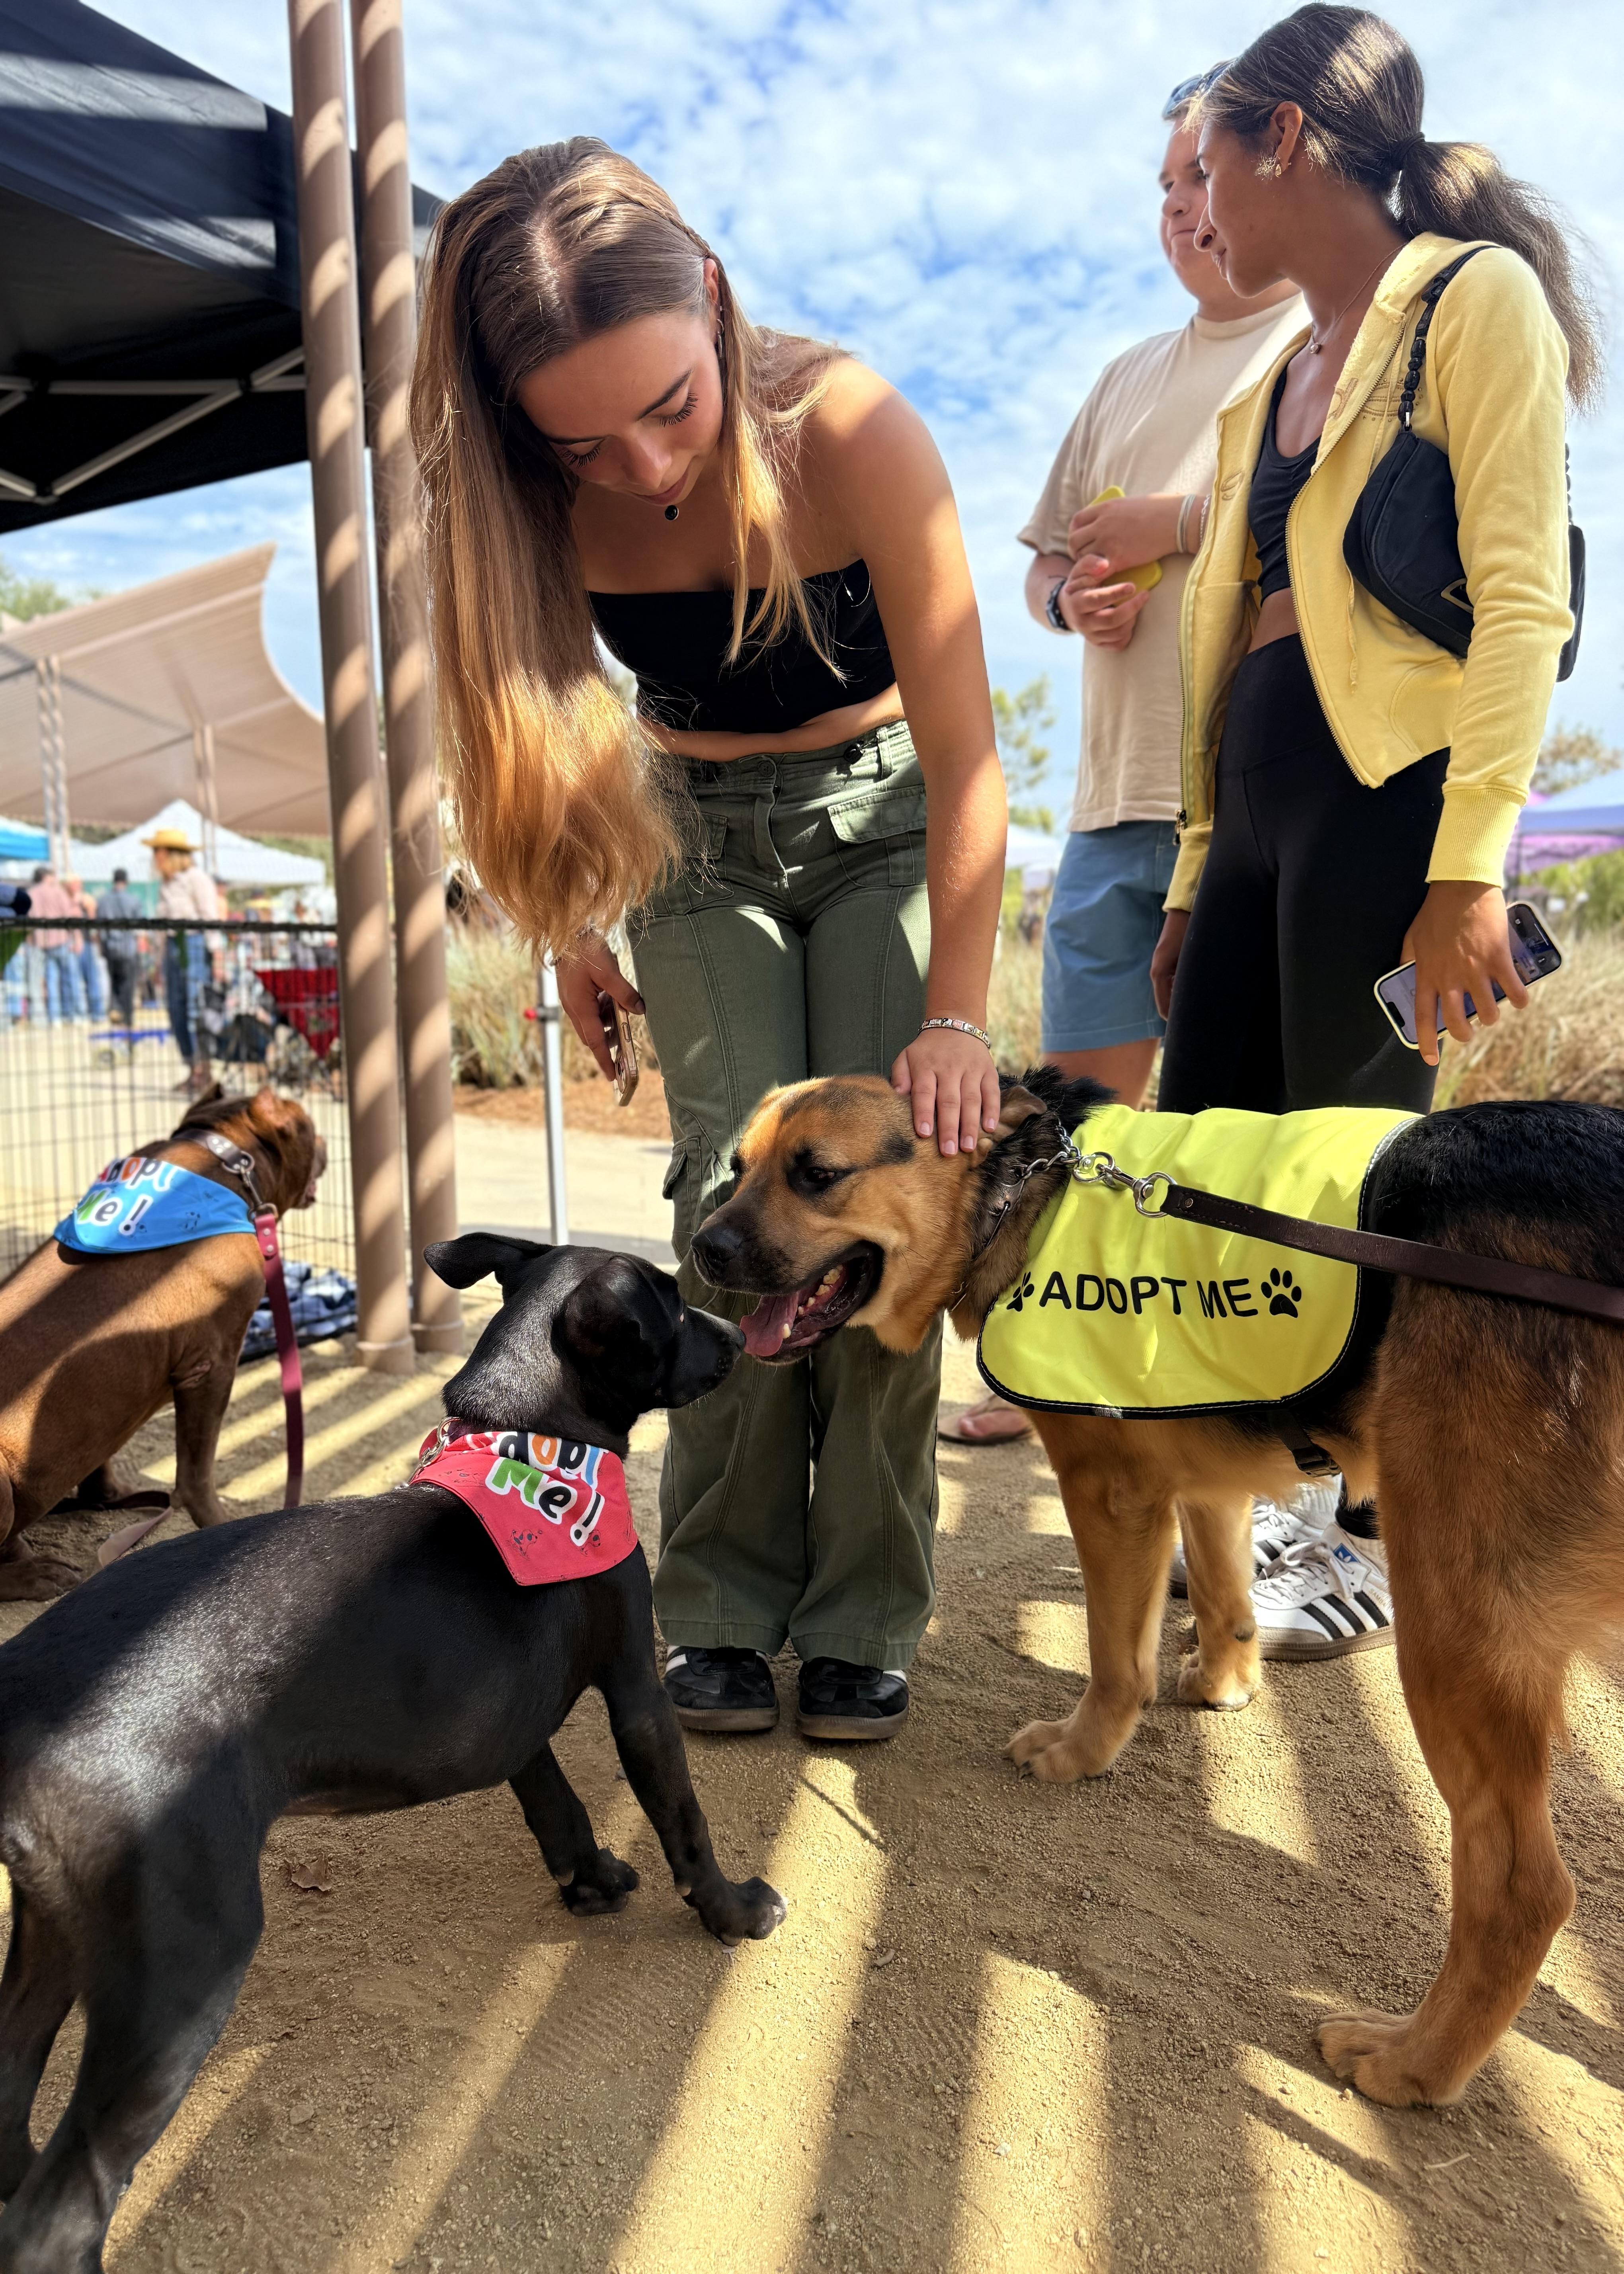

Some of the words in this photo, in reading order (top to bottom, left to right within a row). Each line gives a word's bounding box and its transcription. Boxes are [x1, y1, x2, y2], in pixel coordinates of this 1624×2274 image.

[1039, 1271, 1187, 1315] ADOPT
[1196, 1278, 1258, 1319] ME
[491, 1458, 601, 1540] Me!
